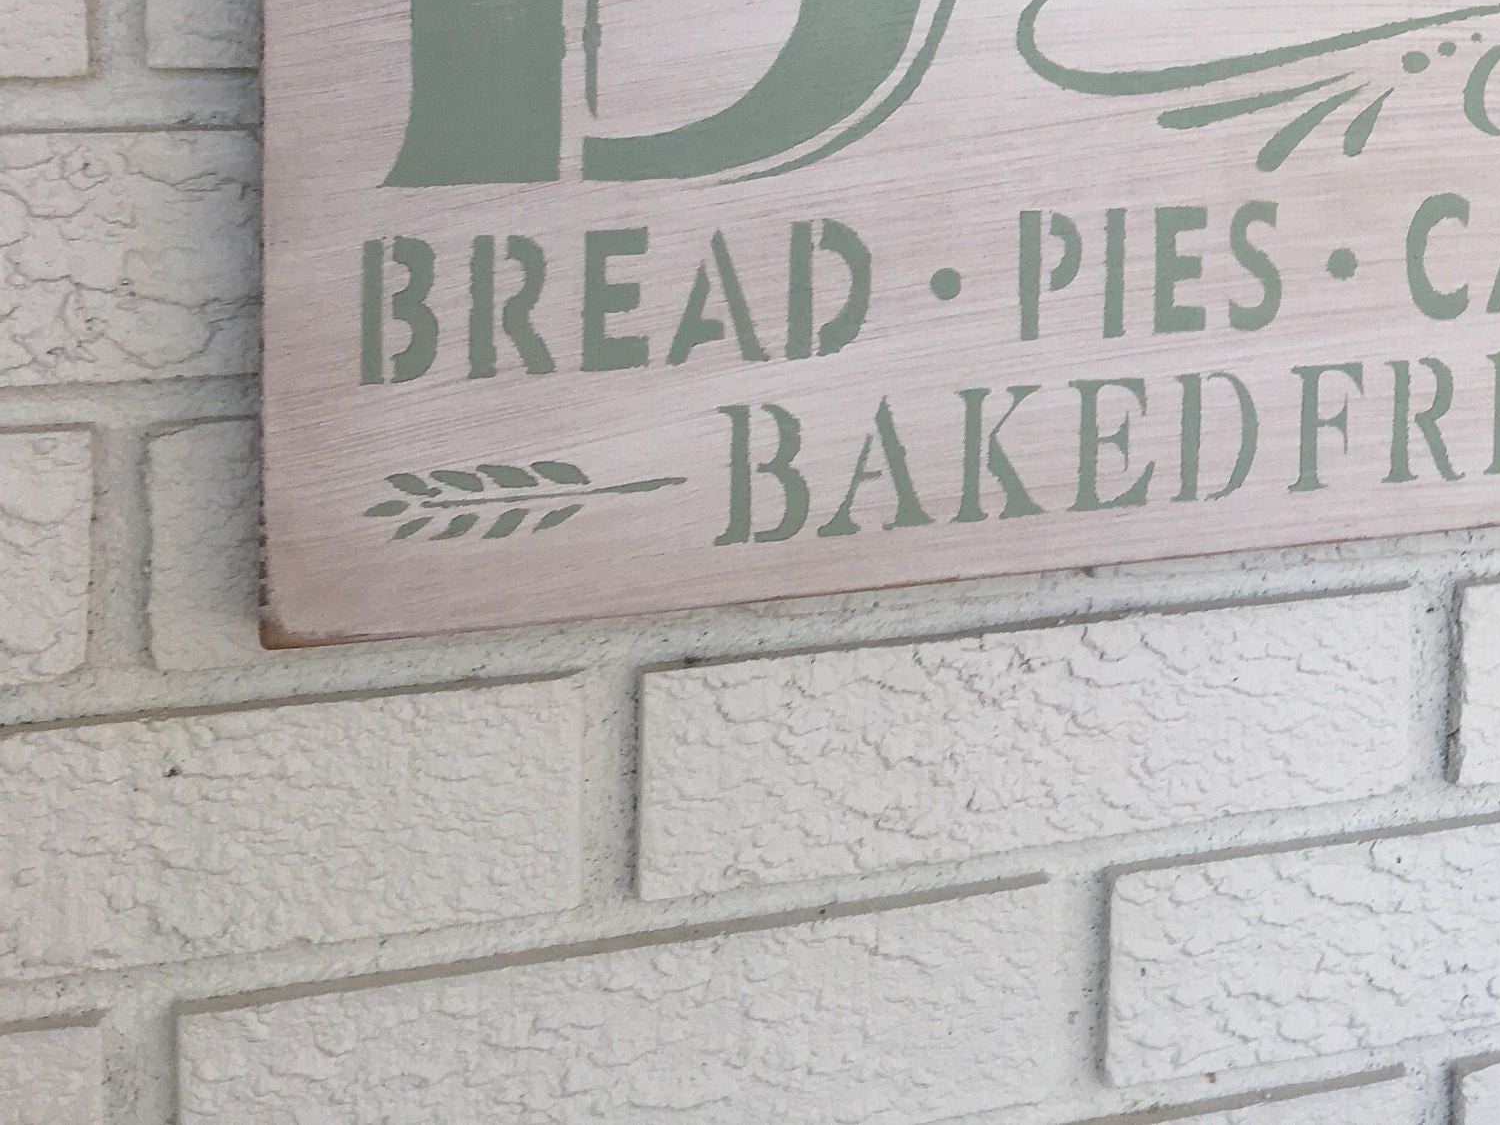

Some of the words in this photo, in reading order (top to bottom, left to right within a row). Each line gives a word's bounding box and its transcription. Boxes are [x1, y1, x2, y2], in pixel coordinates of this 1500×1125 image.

[360, 218, 872, 383] BREAD
[1016, 200, 1283, 341] PIES
[713, 371, 1260, 547] BAKED
